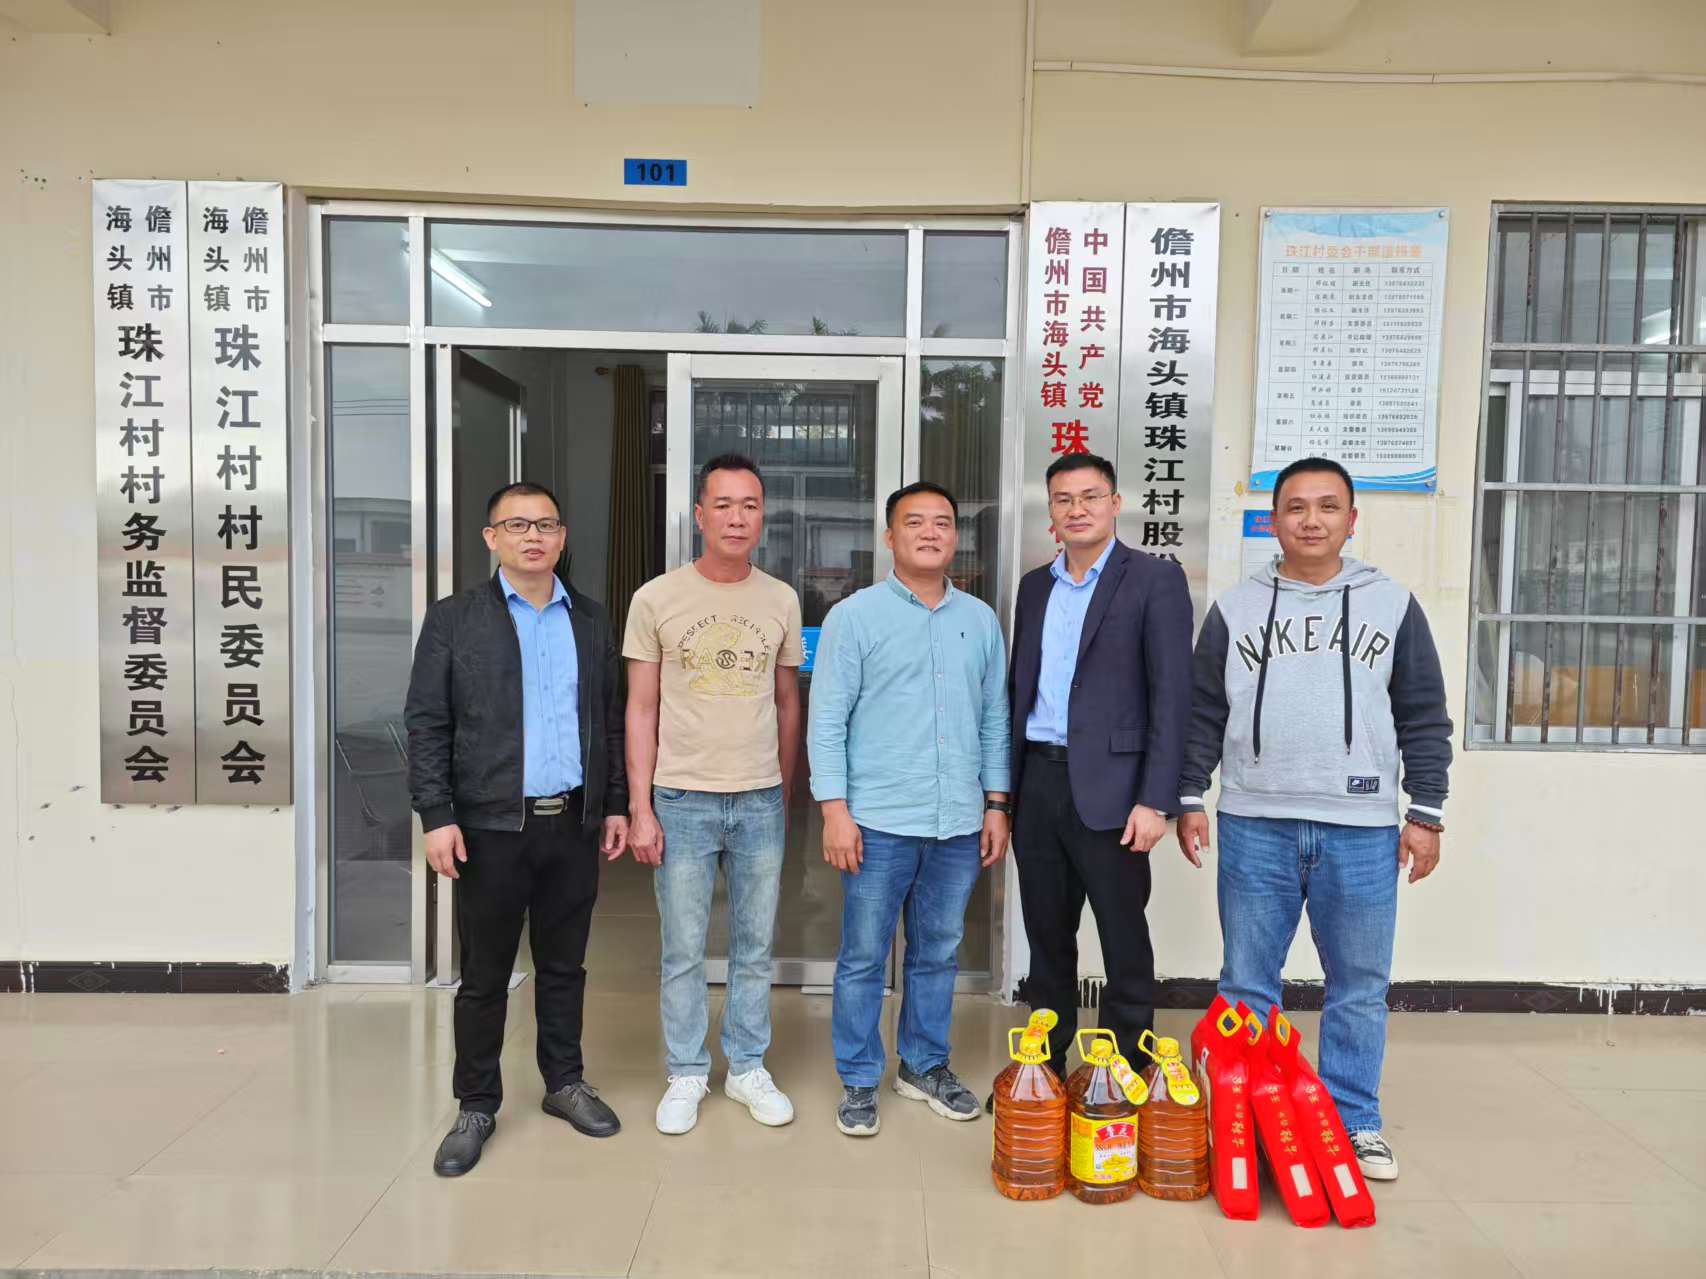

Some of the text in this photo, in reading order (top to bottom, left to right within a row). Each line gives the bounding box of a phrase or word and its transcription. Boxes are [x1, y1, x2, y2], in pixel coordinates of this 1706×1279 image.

[637, 162, 674, 182] 101
[106, 205, 134, 311] 海头镇
[144, 205, 173, 311] 儋州市
[203, 206, 231, 312] 海头镇
[242, 206, 270, 312] 儋州市
[1040, 227, 1071, 408] 儋州市海头镇
[1078, 228, 1108, 408] 中国共产党
[118, 323, 169, 783] 珠江村村务监督委员会
[214, 324, 266, 784] 珠江村村民委员会
[1328, 616, 1390, 670] AIR
